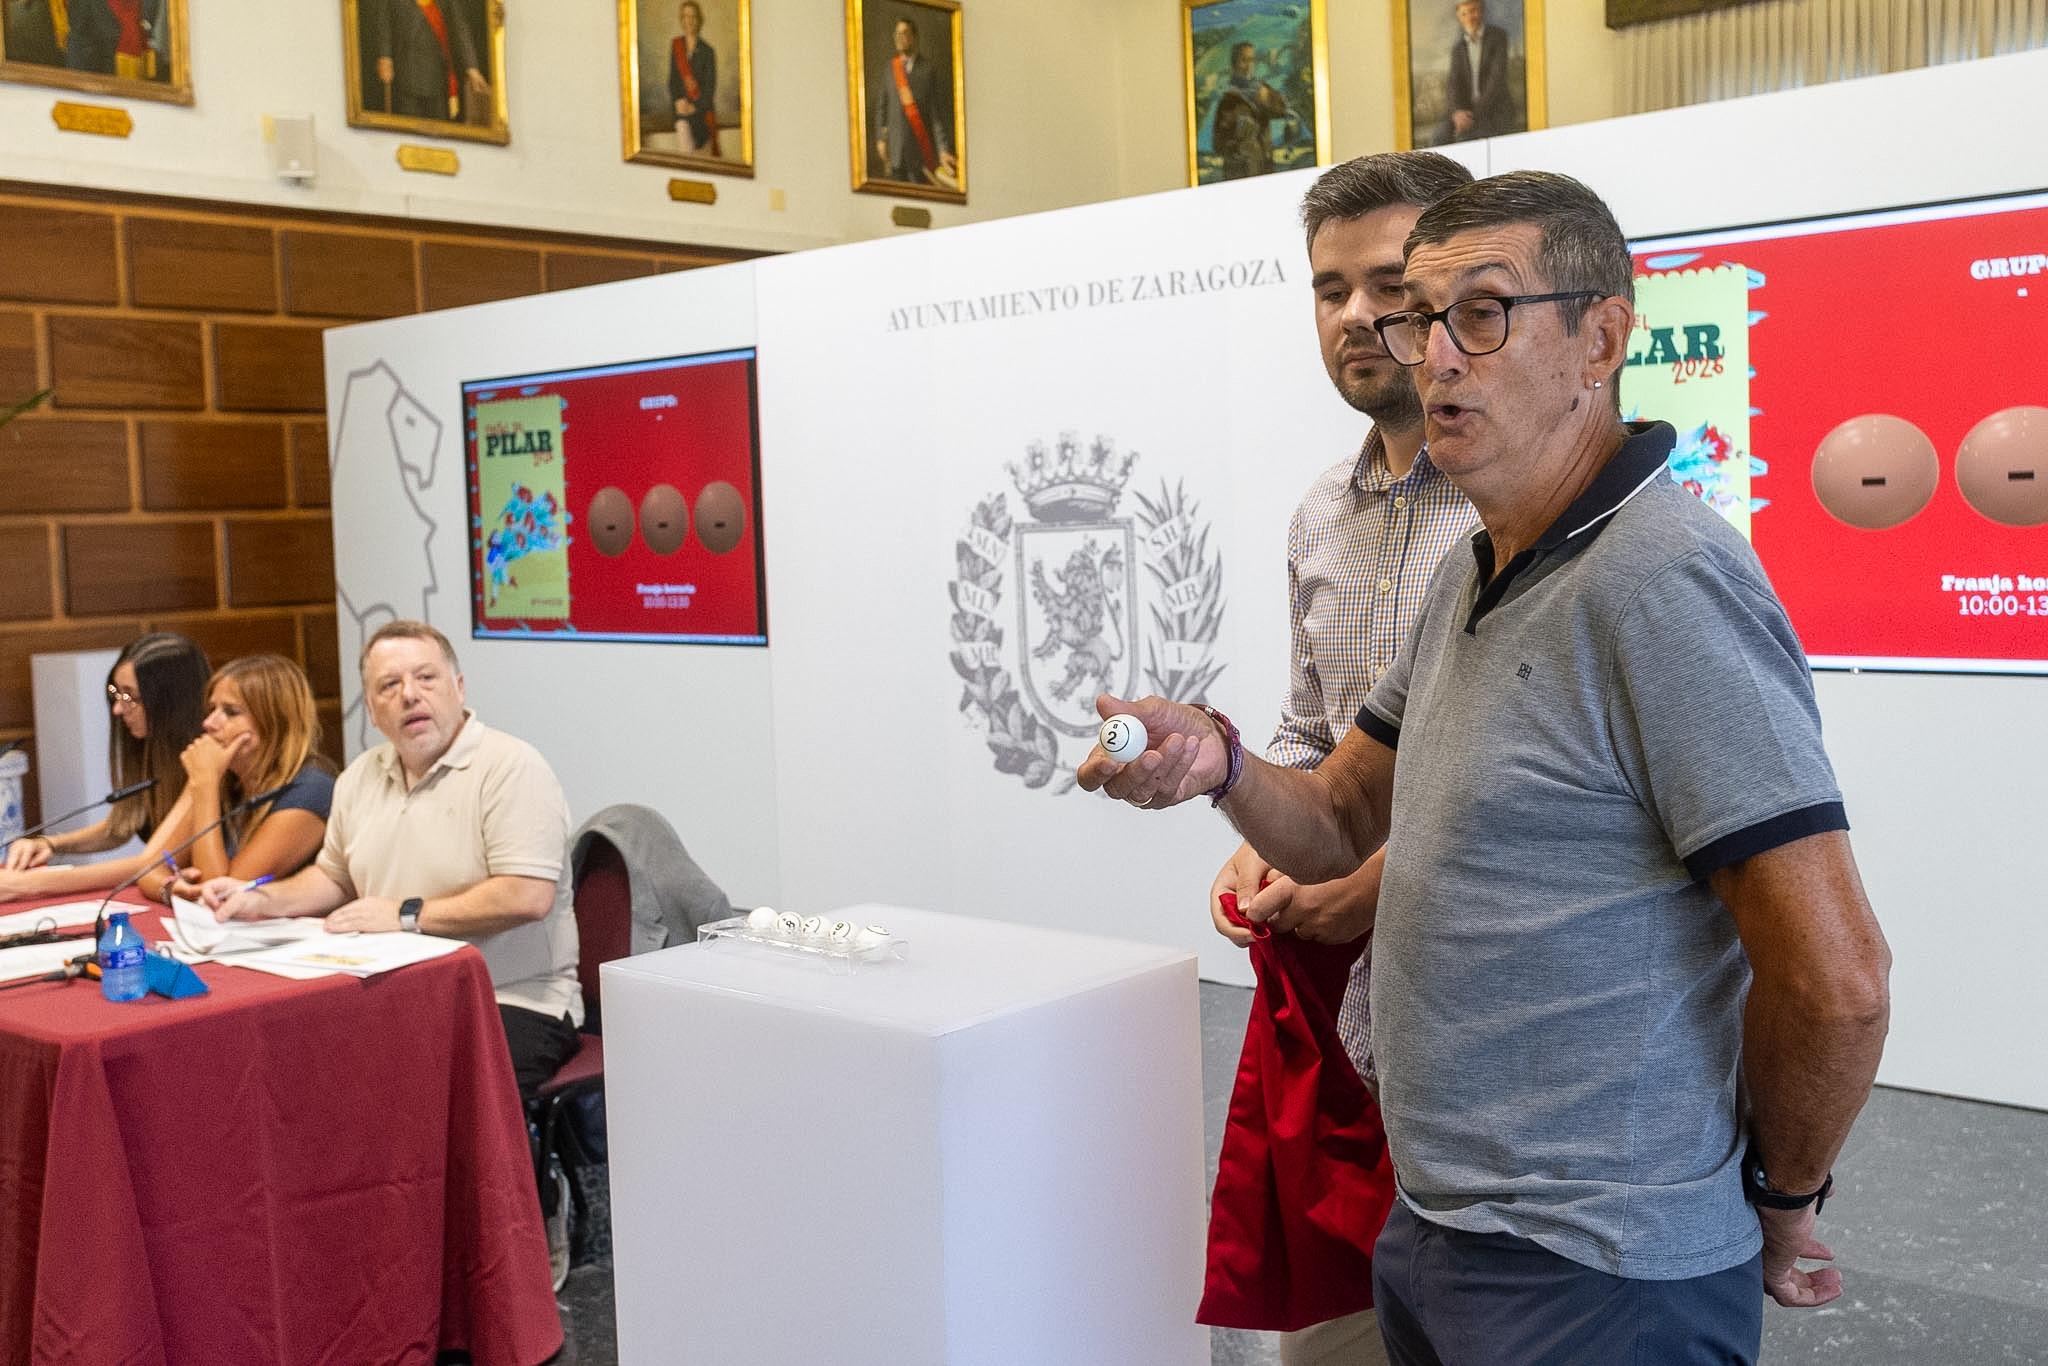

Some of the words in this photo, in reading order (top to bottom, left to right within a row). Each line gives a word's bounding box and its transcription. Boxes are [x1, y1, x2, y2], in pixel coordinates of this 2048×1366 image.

[1970, 254, 2048, 280] GRUP
[887, 285, 1079, 332] AYUNTAMIENTO
[1087, 278, 1124, 307] DE
[1131, 257, 1287, 301] ZARAGOZA
[1672, 355, 1725, 384] 2026
[486, 430, 552, 457] PILAR
[1941, 574, 2014, 595] Franja
[2017, 574, 2048, 591] ho
[1107, 731, 1117, 745] 2
